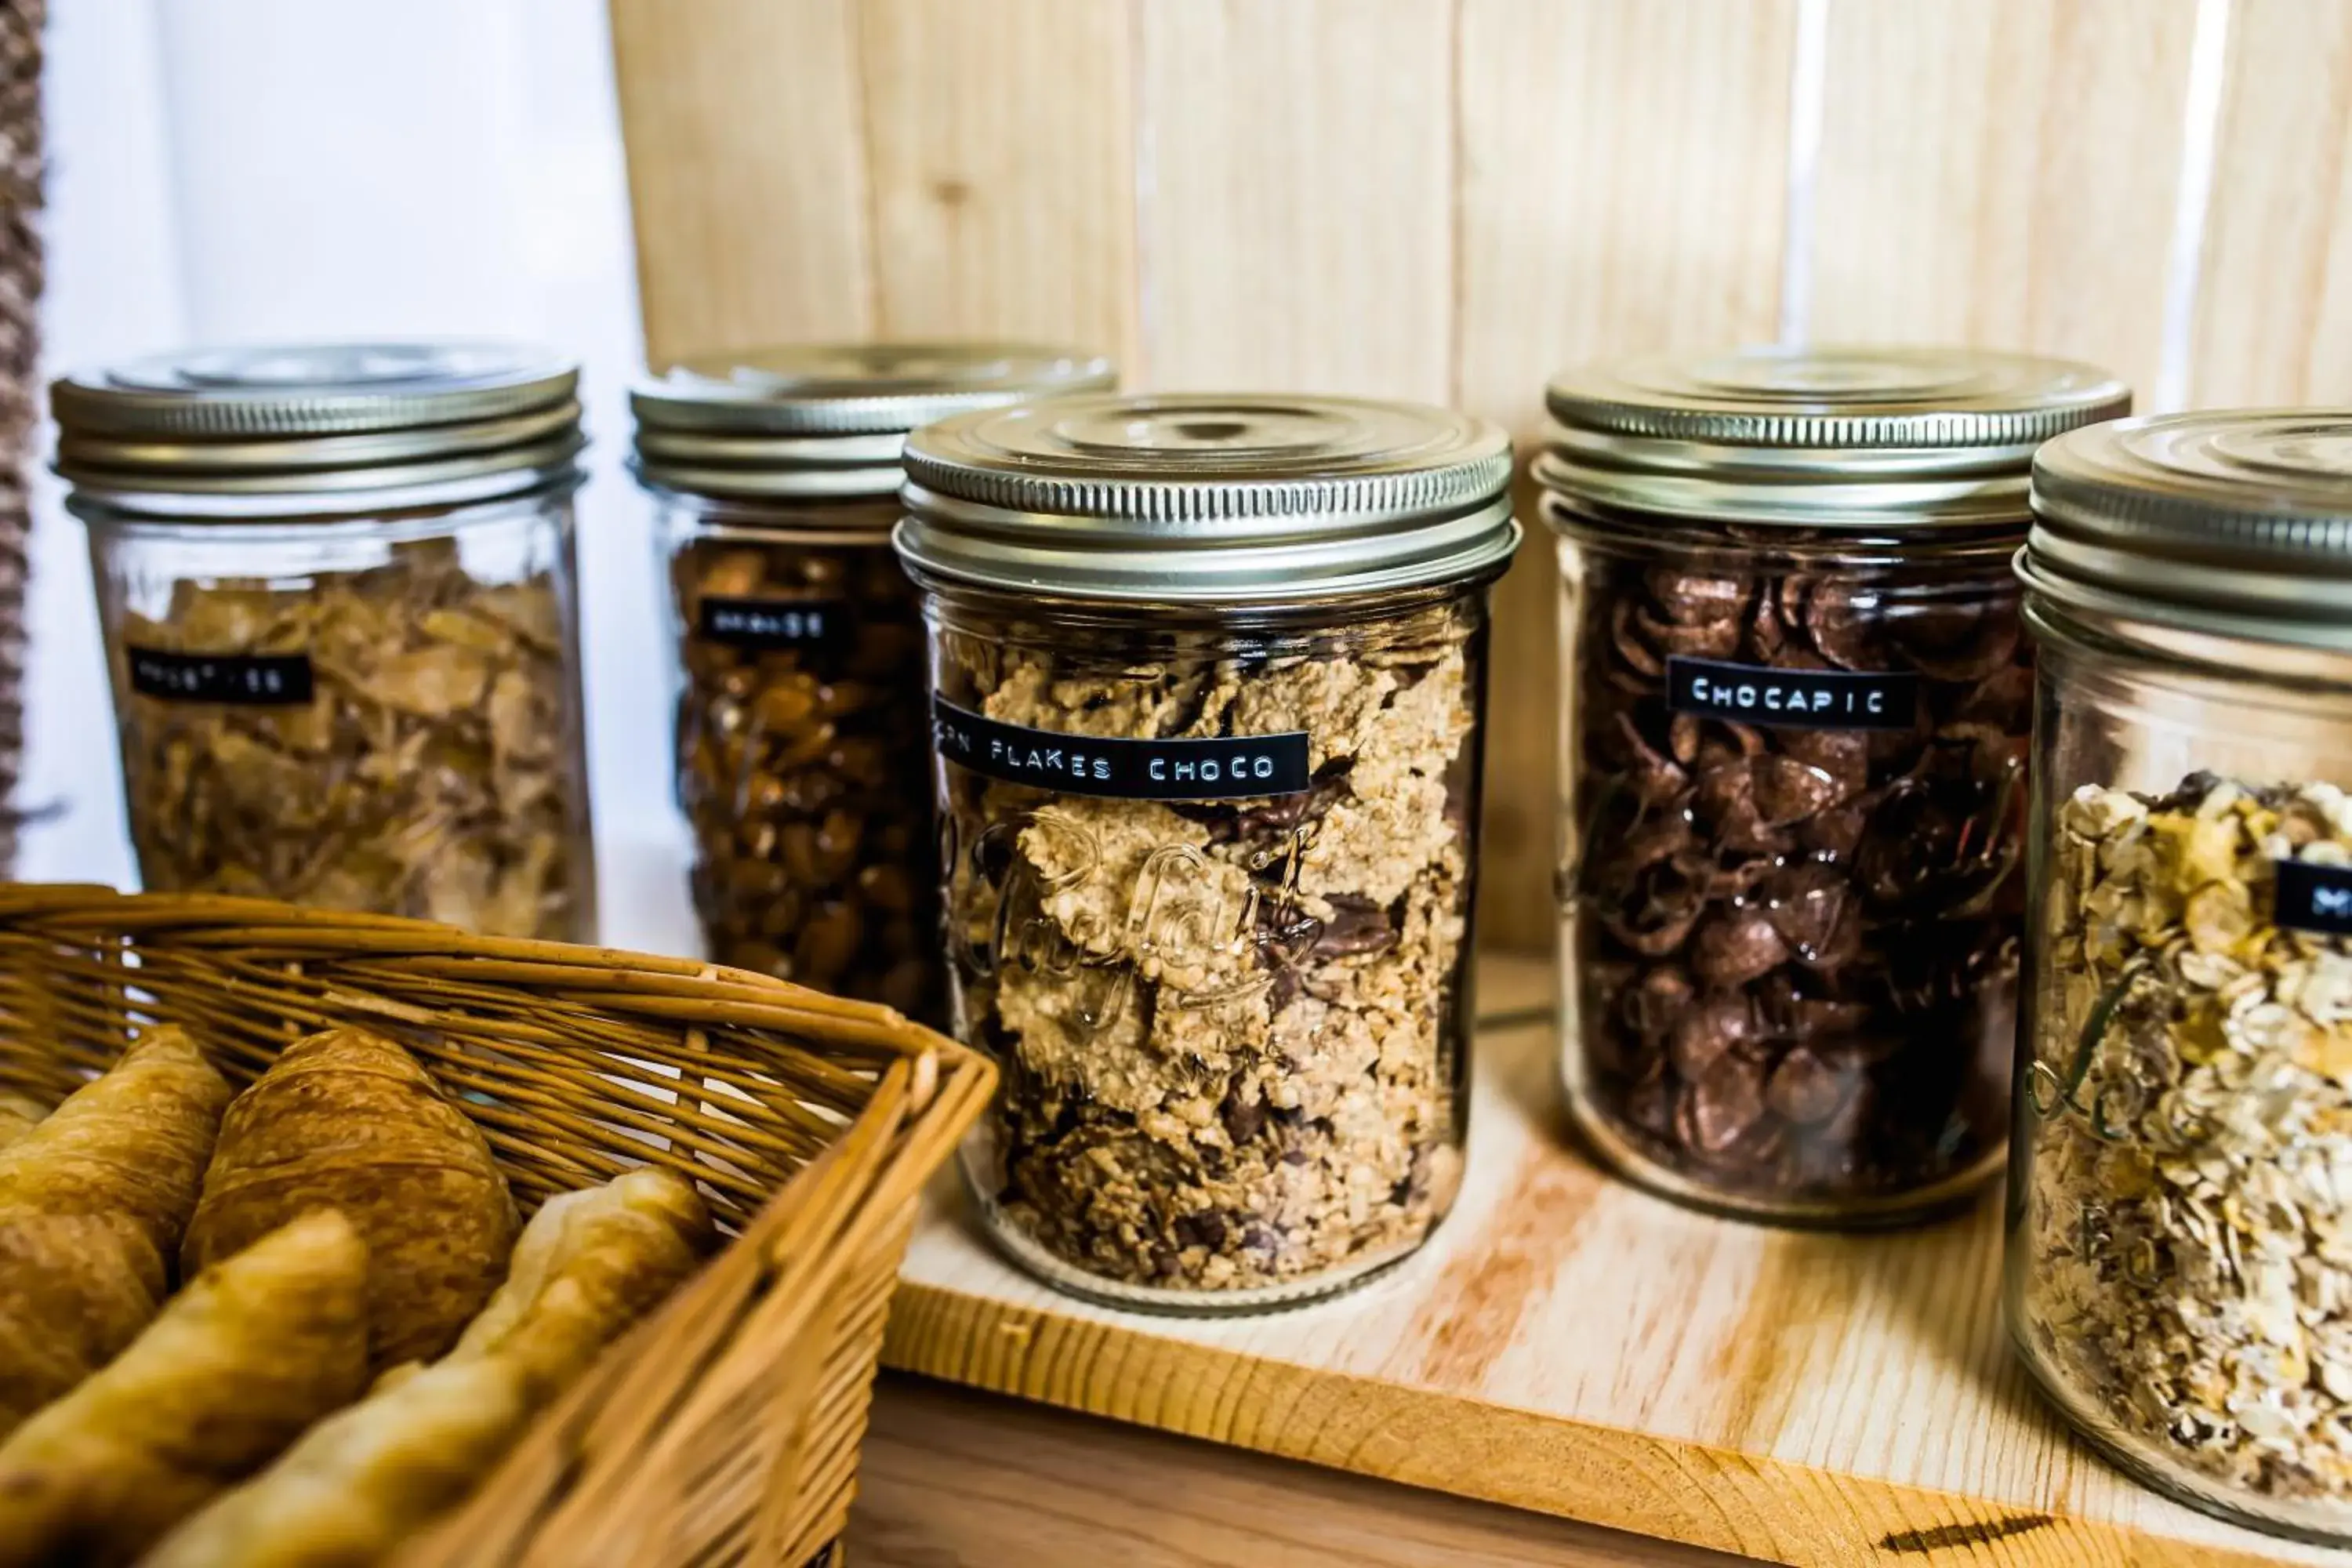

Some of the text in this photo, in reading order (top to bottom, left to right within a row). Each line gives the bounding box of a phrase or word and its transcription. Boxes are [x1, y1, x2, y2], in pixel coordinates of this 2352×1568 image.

[1691, 676, 1884, 713] CHOCAPIC
[990, 739, 1111, 780] FLAKES
[1149, 755, 1275, 782] CHOCO
